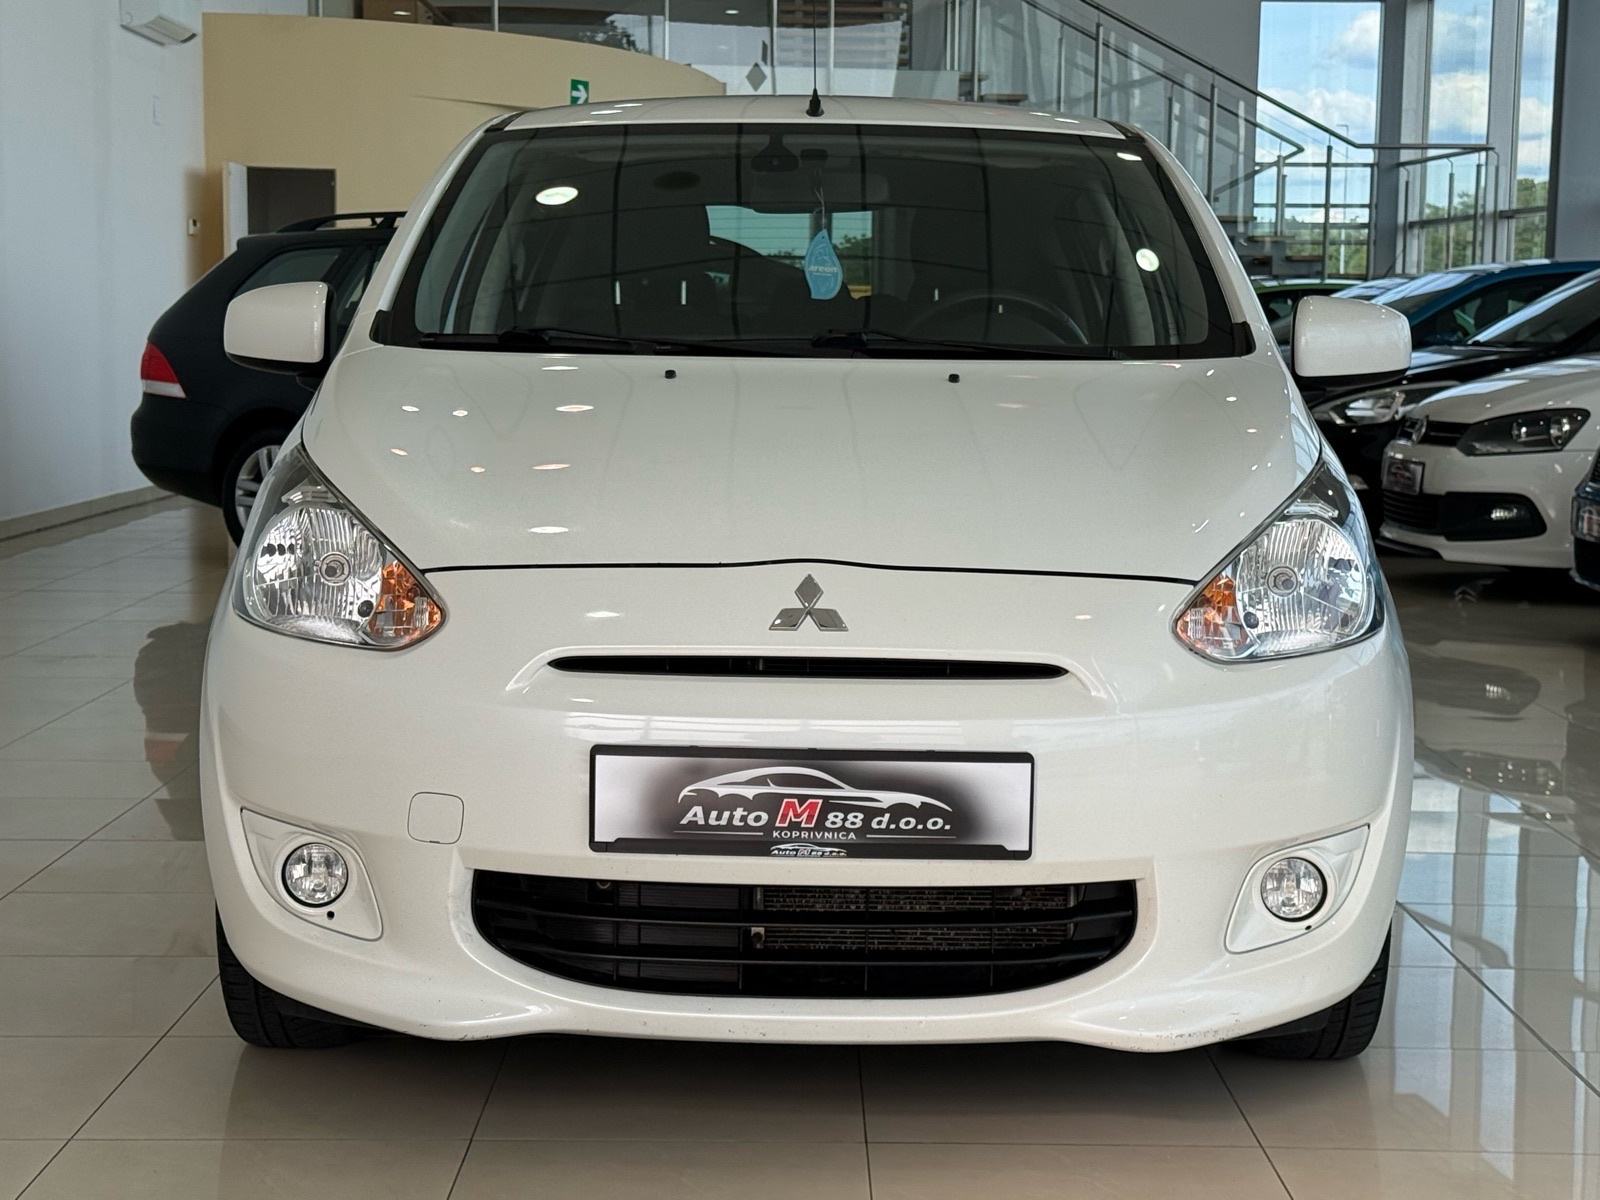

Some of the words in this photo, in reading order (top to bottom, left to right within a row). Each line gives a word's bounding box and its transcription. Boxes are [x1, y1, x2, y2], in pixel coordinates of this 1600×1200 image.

[680, 805, 769, 827] Auto
[775, 798, 823, 828] M
[824, 811, 865, 829] 88
[871, 812, 951, 830] d.o.o.
[772, 830, 857, 840] KOPRIVNICA
